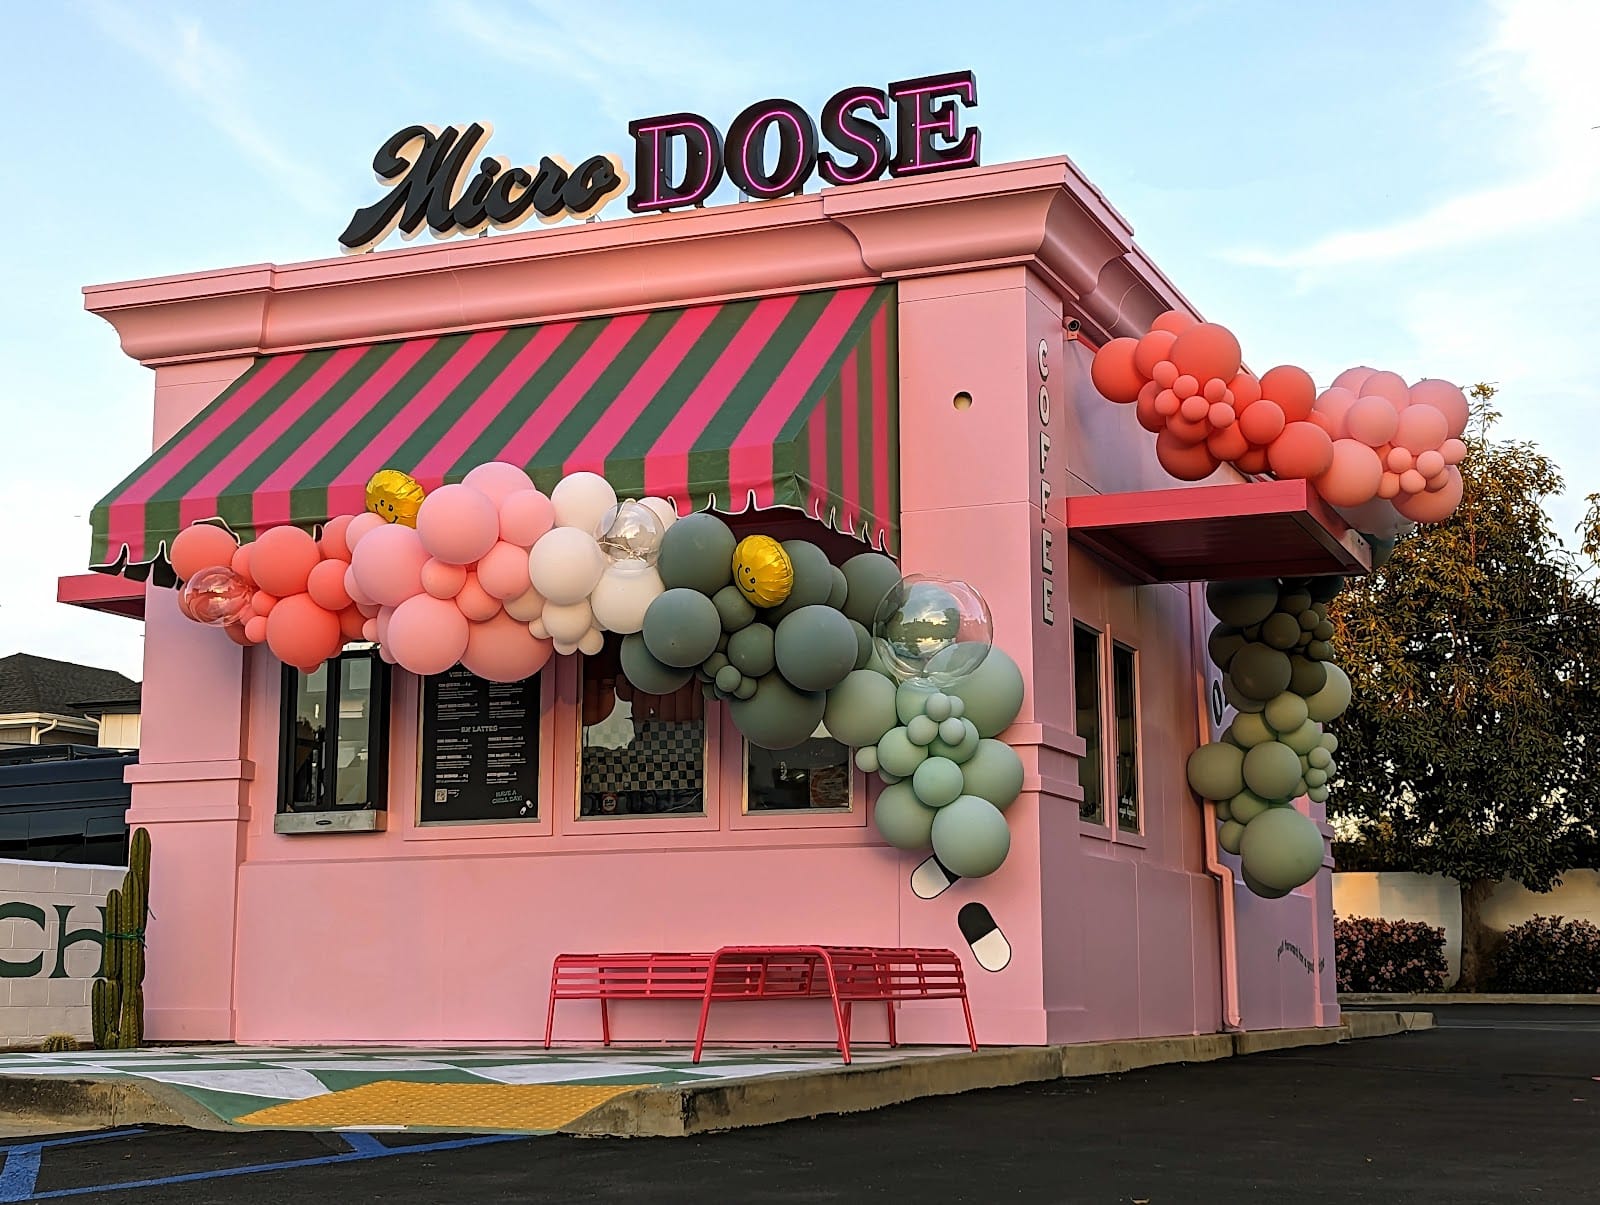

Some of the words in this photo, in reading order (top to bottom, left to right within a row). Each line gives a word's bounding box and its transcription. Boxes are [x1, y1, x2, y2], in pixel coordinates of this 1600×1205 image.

[338, 121, 629, 253] Micro
[627, 70, 981, 213] DOSE
[1038, 338, 1054, 626] COFFEE
[472, 725, 498, 733] LATTES
